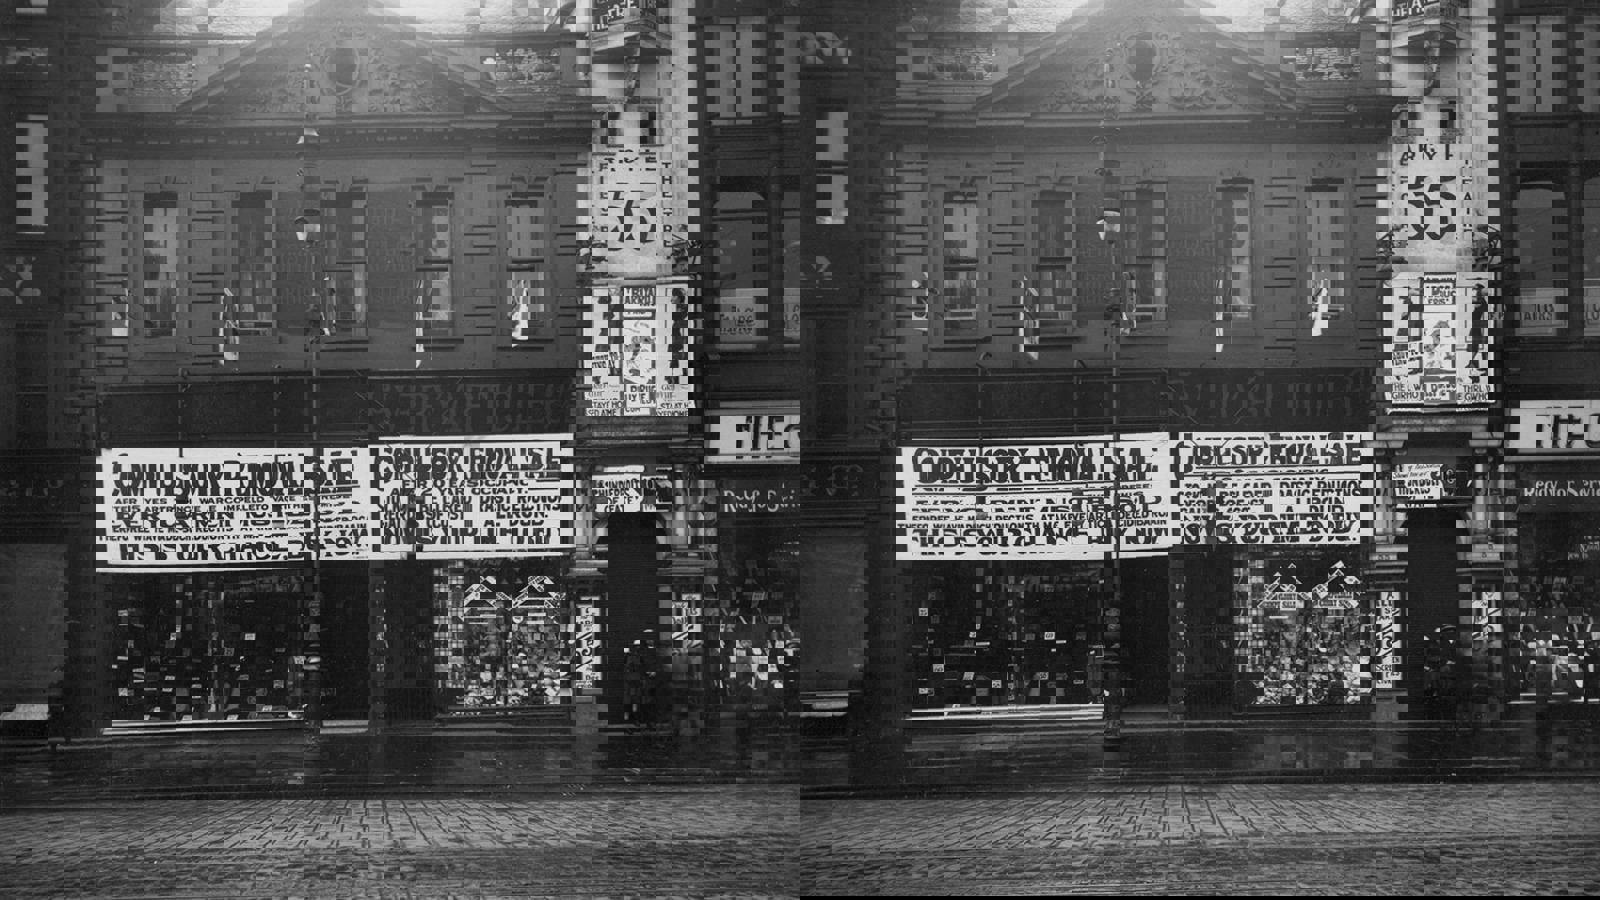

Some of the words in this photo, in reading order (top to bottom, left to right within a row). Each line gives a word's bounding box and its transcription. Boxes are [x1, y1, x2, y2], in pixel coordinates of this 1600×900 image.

[1206, 148, 1313, 164] ARGYLE
[1218, 182, 1306, 245] 55
[1451, 305, 1507, 326] TAILORS
[1199, 390, 1219, 400] GIRL
[1221, 389, 1243, 399] WHO
[1336, 391, 1356, 402] GIRL
[1357, 391, 1379, 401] WHO
[1481, 414, 1560, 452] THE
[757, 440, 928, 484] COMPULSORY
[932, 440, 1049, 473] REMOVAL
[1052, 439, 1122, 472] SALE
[224, 452, 453, 493] COMPULSORY
[461, 451, 608, 491] REMOVAL
[852, 477, 878, 489] 20
[885, 478, 944, 489] YEARS
[226, 497, 265, 506] AFTER
[270, 496, 285, 506] 15
[287, 497, 328, 506] YEARS
[334, 497, 385, 506] TRING
[390, 496, 410, 505] WE
[414, 496, 441, 505] ARE
[448, 495, 521, 505] COMPELLED
[526, 495, 541, 503] TO
[543, 494, 584, 503] VACTE
[588, 493, 620, 502] THES
[760, 490, 801, 507] STOCK
[851, 490, 870, 507] BE
[874, 489, 936, 506] CLEARED
[959, 489, 1023, 505] DRASTIC
[1028, 487, 1122, 504] REDUCTIONS
[1212, 496, 1228, 508] OF
[1459, 481, 1510, 505] Ready
[1519, 481, 1543, 505] for
[228, 507, 323, 521] EVERY
[574, 503, 616, 518] BE
[632, 500, 715, 516] SOLD
[763, 507, 852, 522] REGARDS
[858, 507, 877, 522] OF
[979, 505, 1013, 519] ALL
[209, 523, 273, 533] THEREFORE
[277, 523, 294, 533] WE
[298, 523, 324, 533] HAVE
[387, 521, 458, 533] REDUCTIONS
[465, 521, 495, 532] THAT
[499, 520, 532, 531] MAKE
[637, 516, 685, 528] DECIDED
[687, 514, 735, 527] BARGAIN
[838, 522, 867, 545] IS
[870, 522, 944, 545] YOUR
[949, 520, 1012, 543] TIME
[1018, 519, 1053, 543] TO
[224, 535, 305, 556] THIS
[313, 535, 345, 556] IS
[351, 534, 431, 556] YOUR
[1160, 612, 1189, 623] STARS
[1161, 627, 1187, 657] 55
